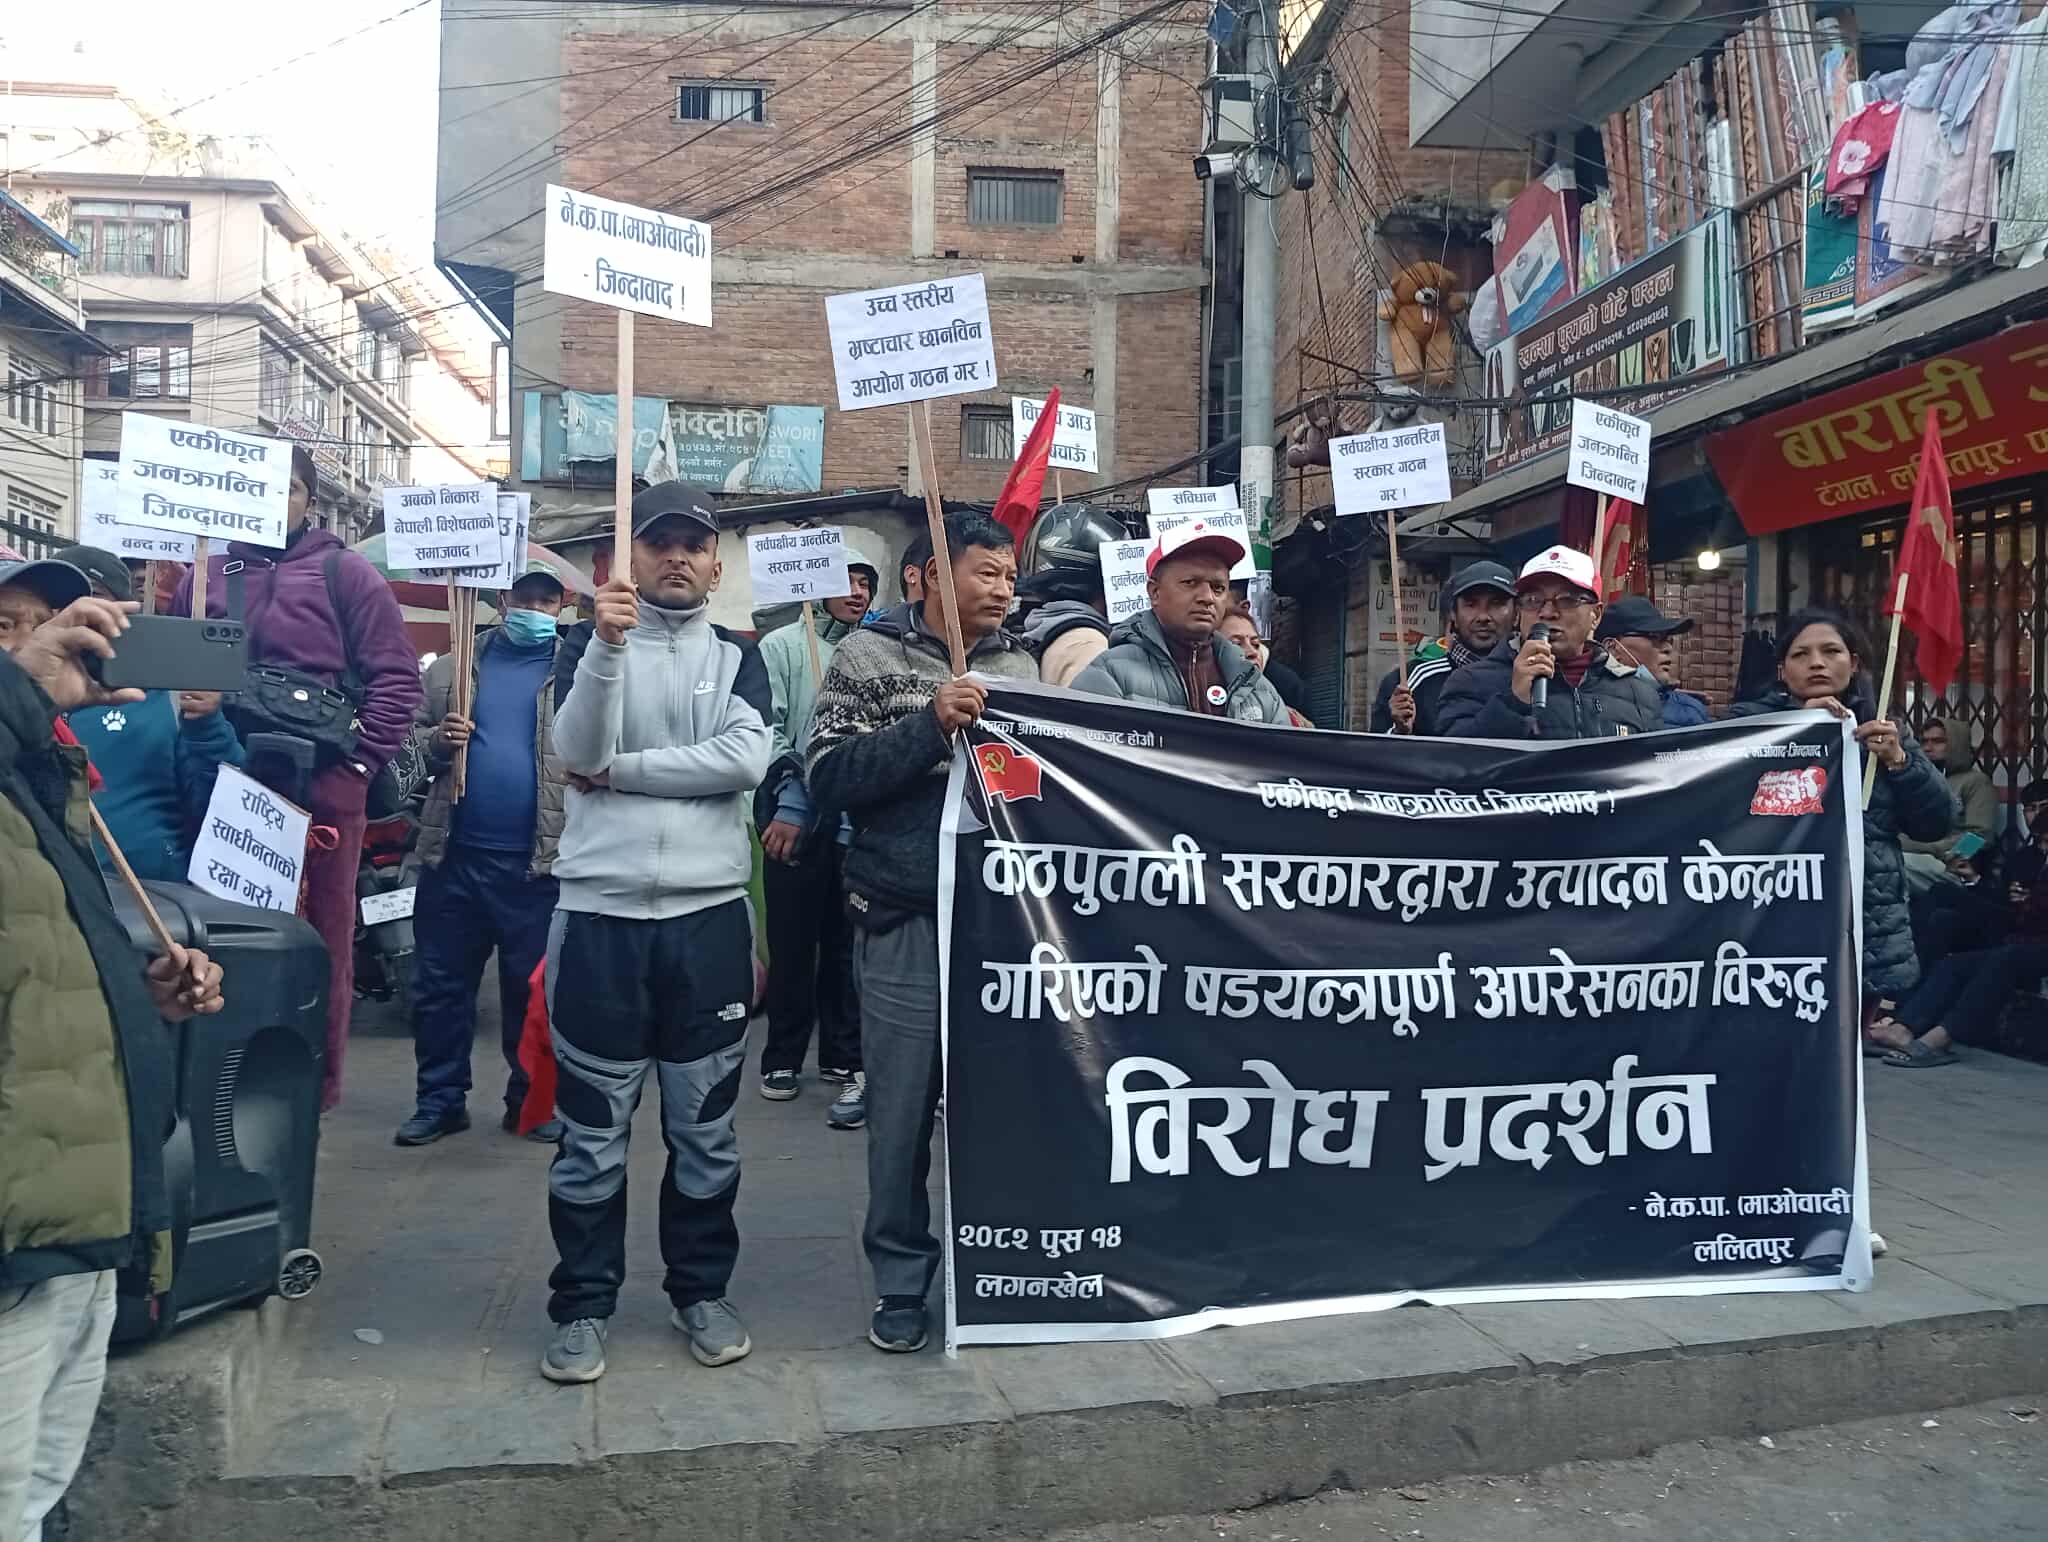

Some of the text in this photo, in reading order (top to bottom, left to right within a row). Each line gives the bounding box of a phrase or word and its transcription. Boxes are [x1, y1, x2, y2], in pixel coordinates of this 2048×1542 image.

[560, 192, 706, 258] ने.क.पा.(माओवादी)
[865, 283, 954, 316] उच्च स्तरीय
[848, 332, 914, 360] भ्रष्टाचार
[851, 371, 905, 397] आयोग
[909, 366, 949, 388] गठन
[953, 362, 979, 381] गर
[1596, 412, 1640, 439] एकीकृत
[1774, 358, 1994, 468] बाराही
[169, 429, 268, 463] एकीकृत
[1337, 428, 1440, 456] सर्वपक्षीय अन्तरिम
[1578, 435, 1640, 464] जनक्रान्ति
[133, 460, 268, 497] जनक्रान्ति
[1353, 458, 1427, 480] सरकार गठन
[400, 490, 436, 507] अबको
[440, 488, 480, 505] निकास
[1173, 490, 1216, 505] संविधान
[1379, 488, 1398, 501] गर
[394, 517, 432, 534] नेपाली
[437, 513, 494, 533] विशेषताको
[415, 545, 471, 560] समाजवाद
[754, 530, 840, 552] सर्वपक्षीय अन्तरिम
[1116, 544, 1145, 561] संविधान
[768, 557, 830, 575] सरकार गठन
[791, 583, 806, 594] गर
[241, 789, 286, 832] राष्ट्रिय
[1257, 777, 1354, 819] एकीकृत
[212, 817, 297, 882] स्वाधीनताको
[208, 859, 240, 891] रक्षा
[982, 833, 1825, 922] कठपुतली सरकारद्वारा उत्पादन केन्द्रमा
[981, 942, 1167, 1022] गरिएको
[1184, 951, 1456, 1038] षडयन्त्रपूर्ण
[1469, 947, 1704, 1019] अपरेसनका
[1105, 1054, 1718, 1183] विरोध प्रदर्शन
[1644, 1192, 1731, 1218] ने.क.पा.
[958, 1224, 1122, 1258] २०८२ पुस १४
[1693, 1233, 1795, 1264] ललितपुर
[975, 1271, 1104, 1299] लगनखेल
